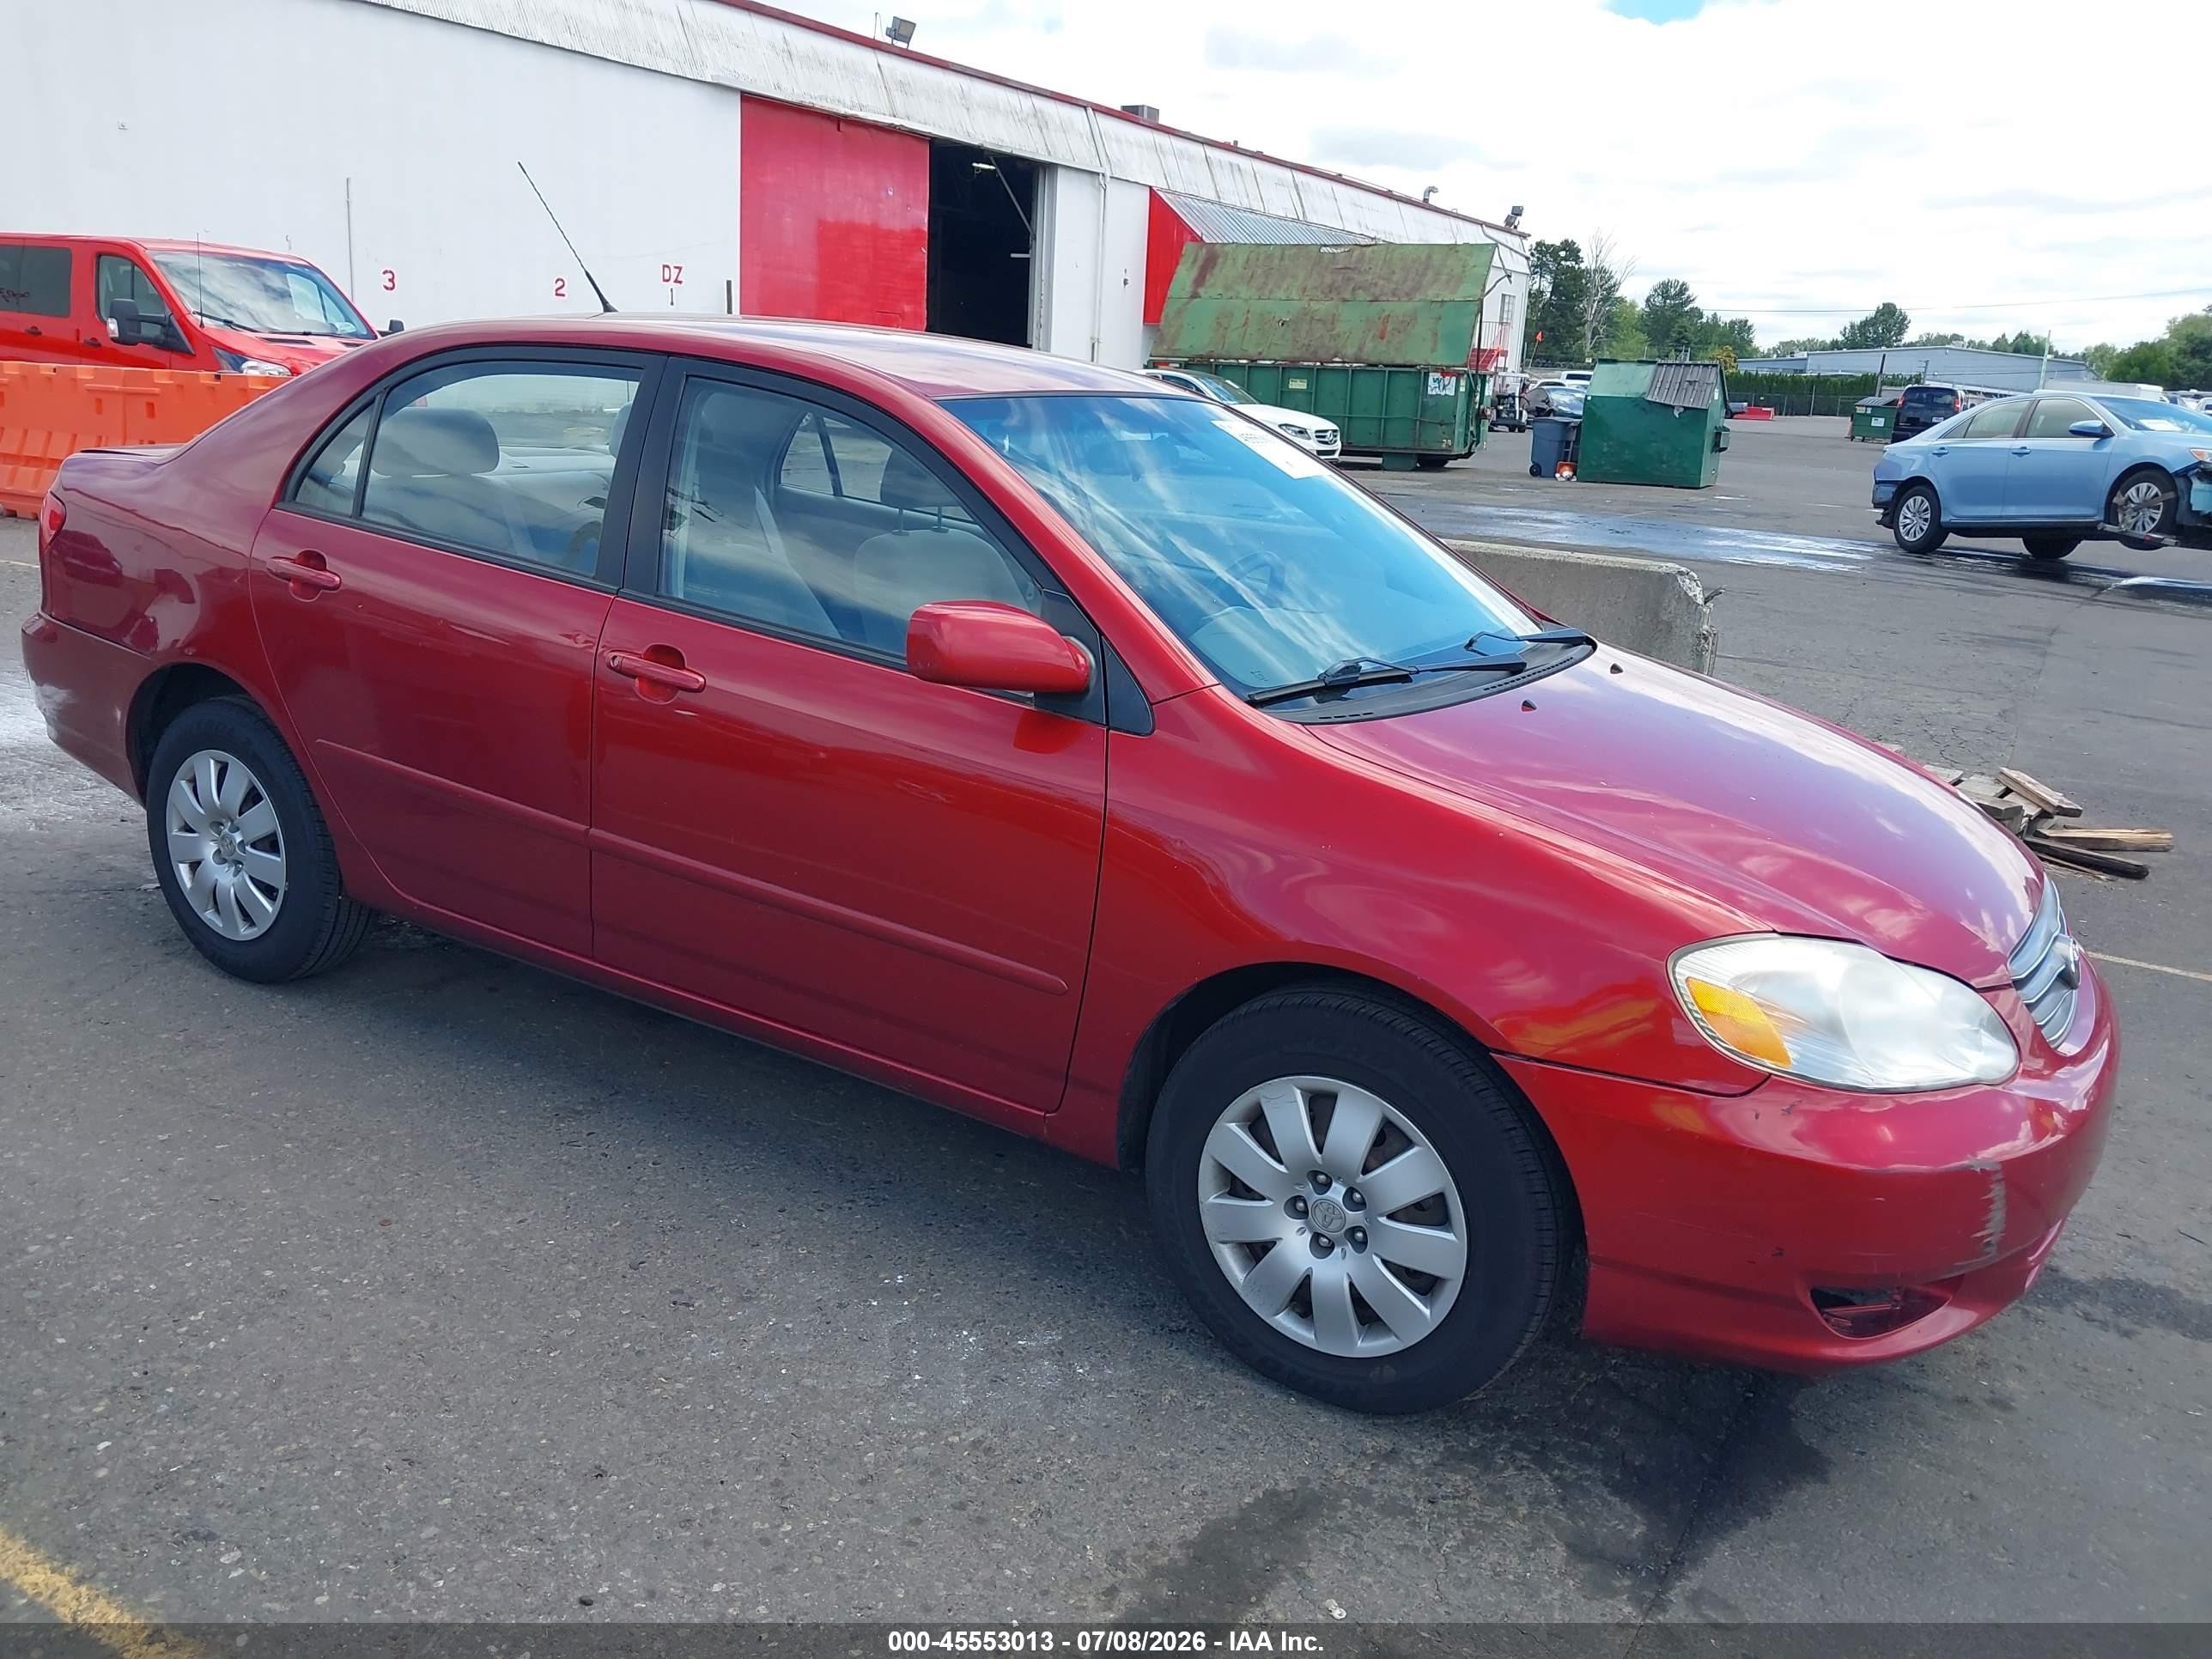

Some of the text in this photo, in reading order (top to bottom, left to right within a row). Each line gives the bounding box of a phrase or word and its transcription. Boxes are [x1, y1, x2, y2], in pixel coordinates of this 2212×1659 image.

[382, 269, 396, 291] 3
[662, 264, 684, 285] DZ
[554, 277, 566, 297] 2
